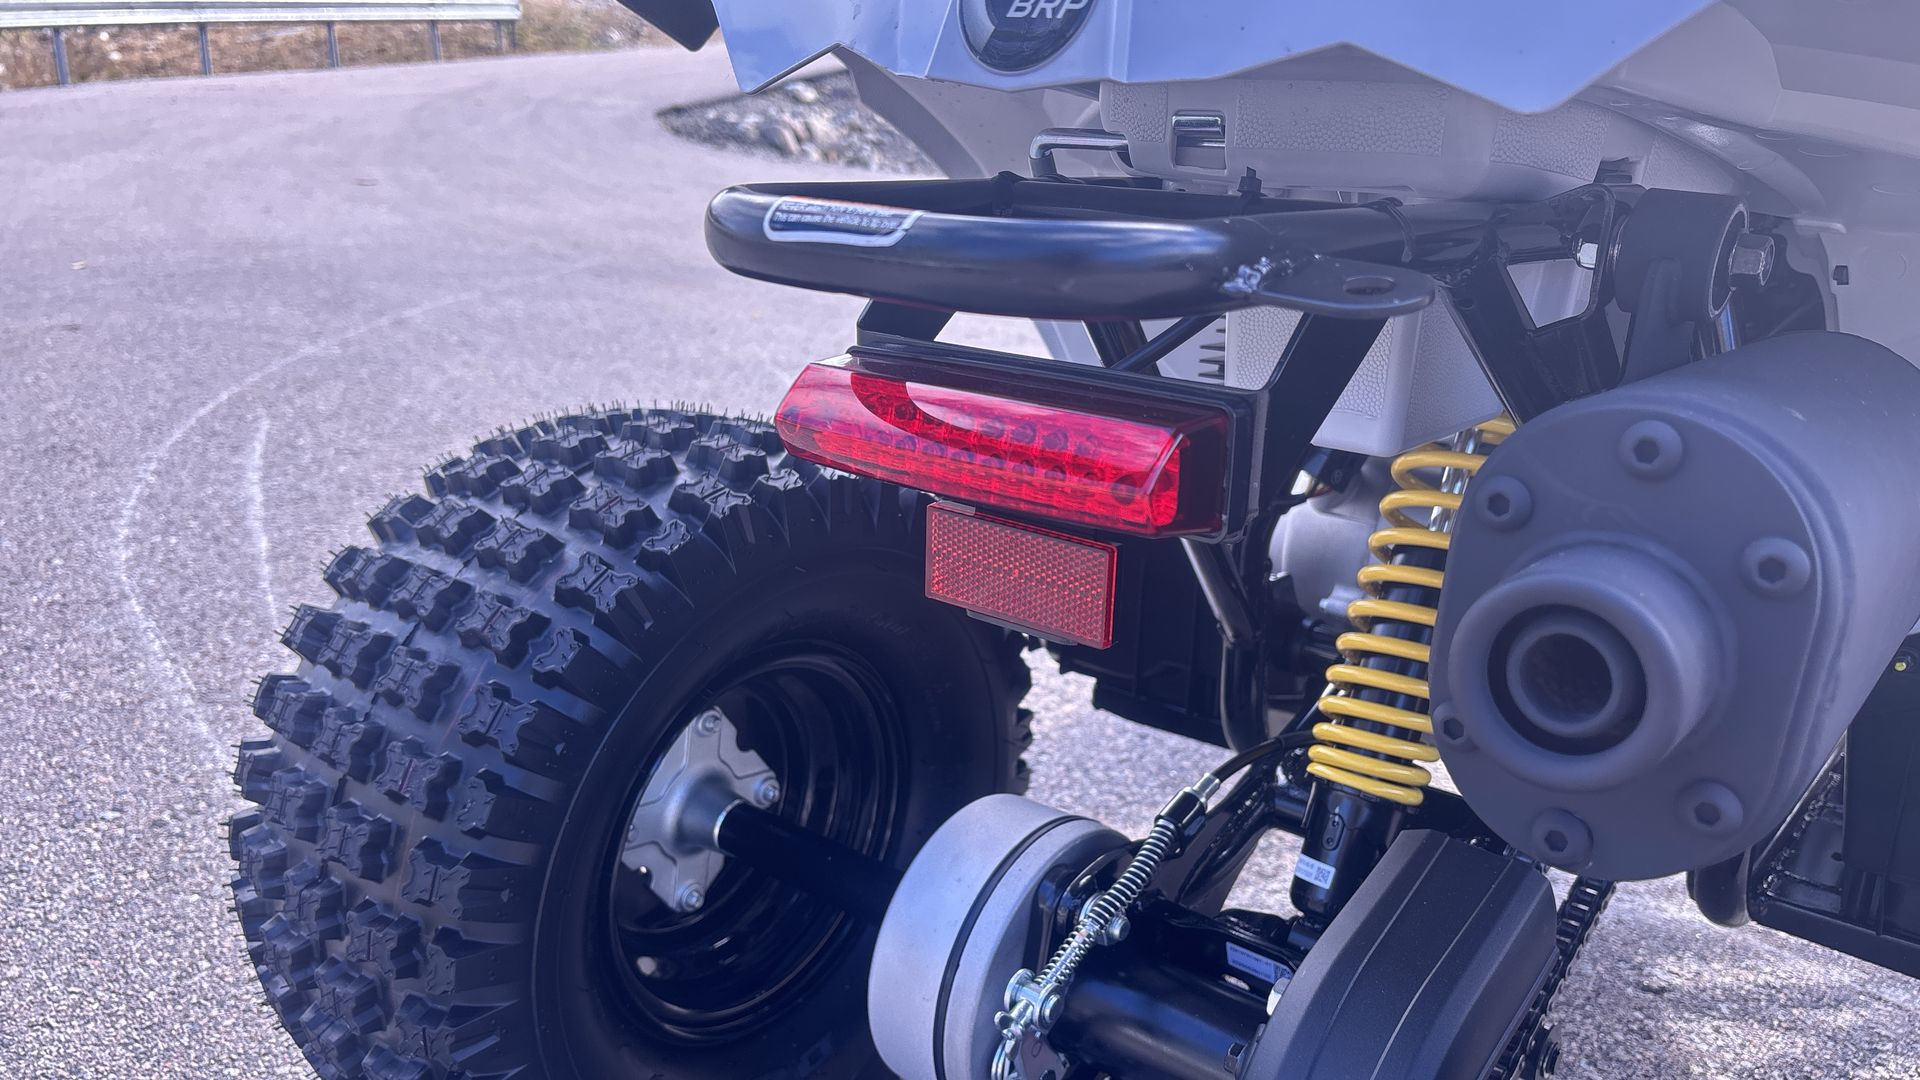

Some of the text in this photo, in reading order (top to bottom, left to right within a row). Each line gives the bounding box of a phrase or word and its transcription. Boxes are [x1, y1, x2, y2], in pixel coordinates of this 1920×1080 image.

[1006, 0, 1089, 19] BRP
[775, 212, 787, 222] This
[788, 213, 800, 222] can
